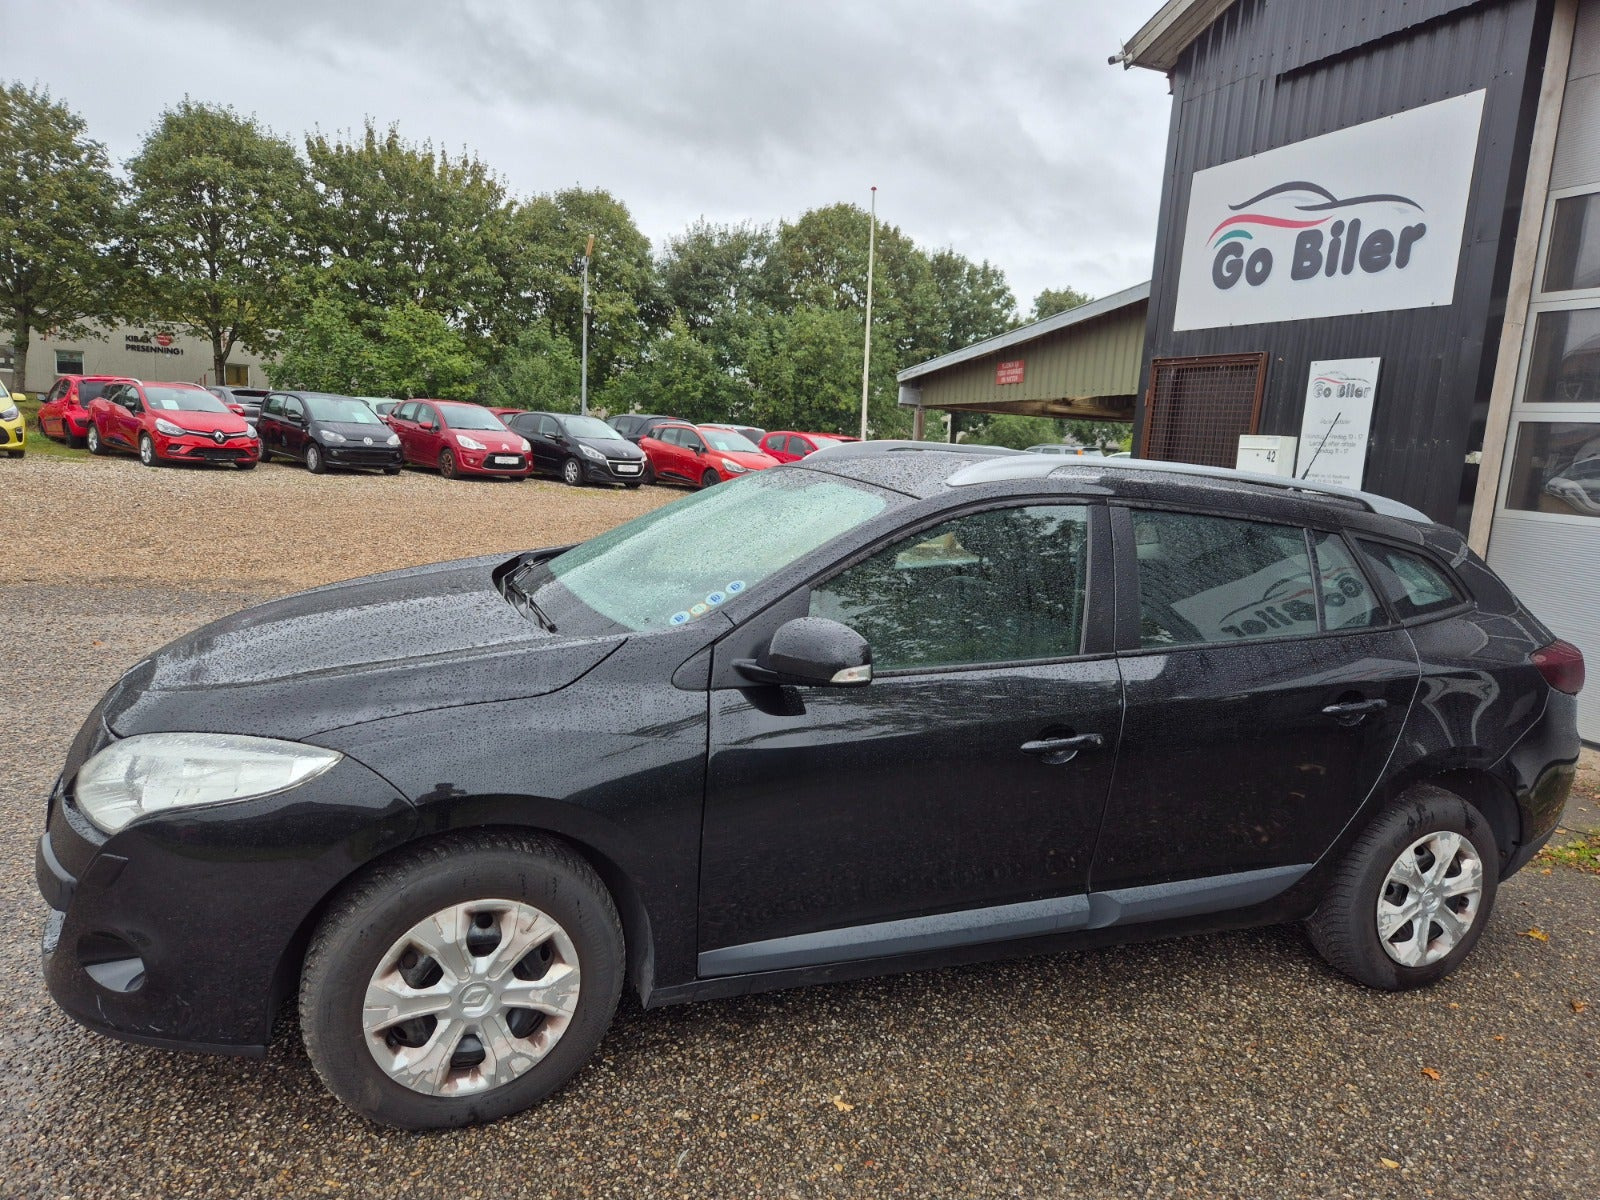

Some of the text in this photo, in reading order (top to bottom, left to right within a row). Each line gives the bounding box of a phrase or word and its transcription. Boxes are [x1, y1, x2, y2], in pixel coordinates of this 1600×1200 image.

[1212, 218, 1427, 290] Go Biler
[1337, 383, 1371, 399] Biler
[1266, 450, 1276, 462] 42
